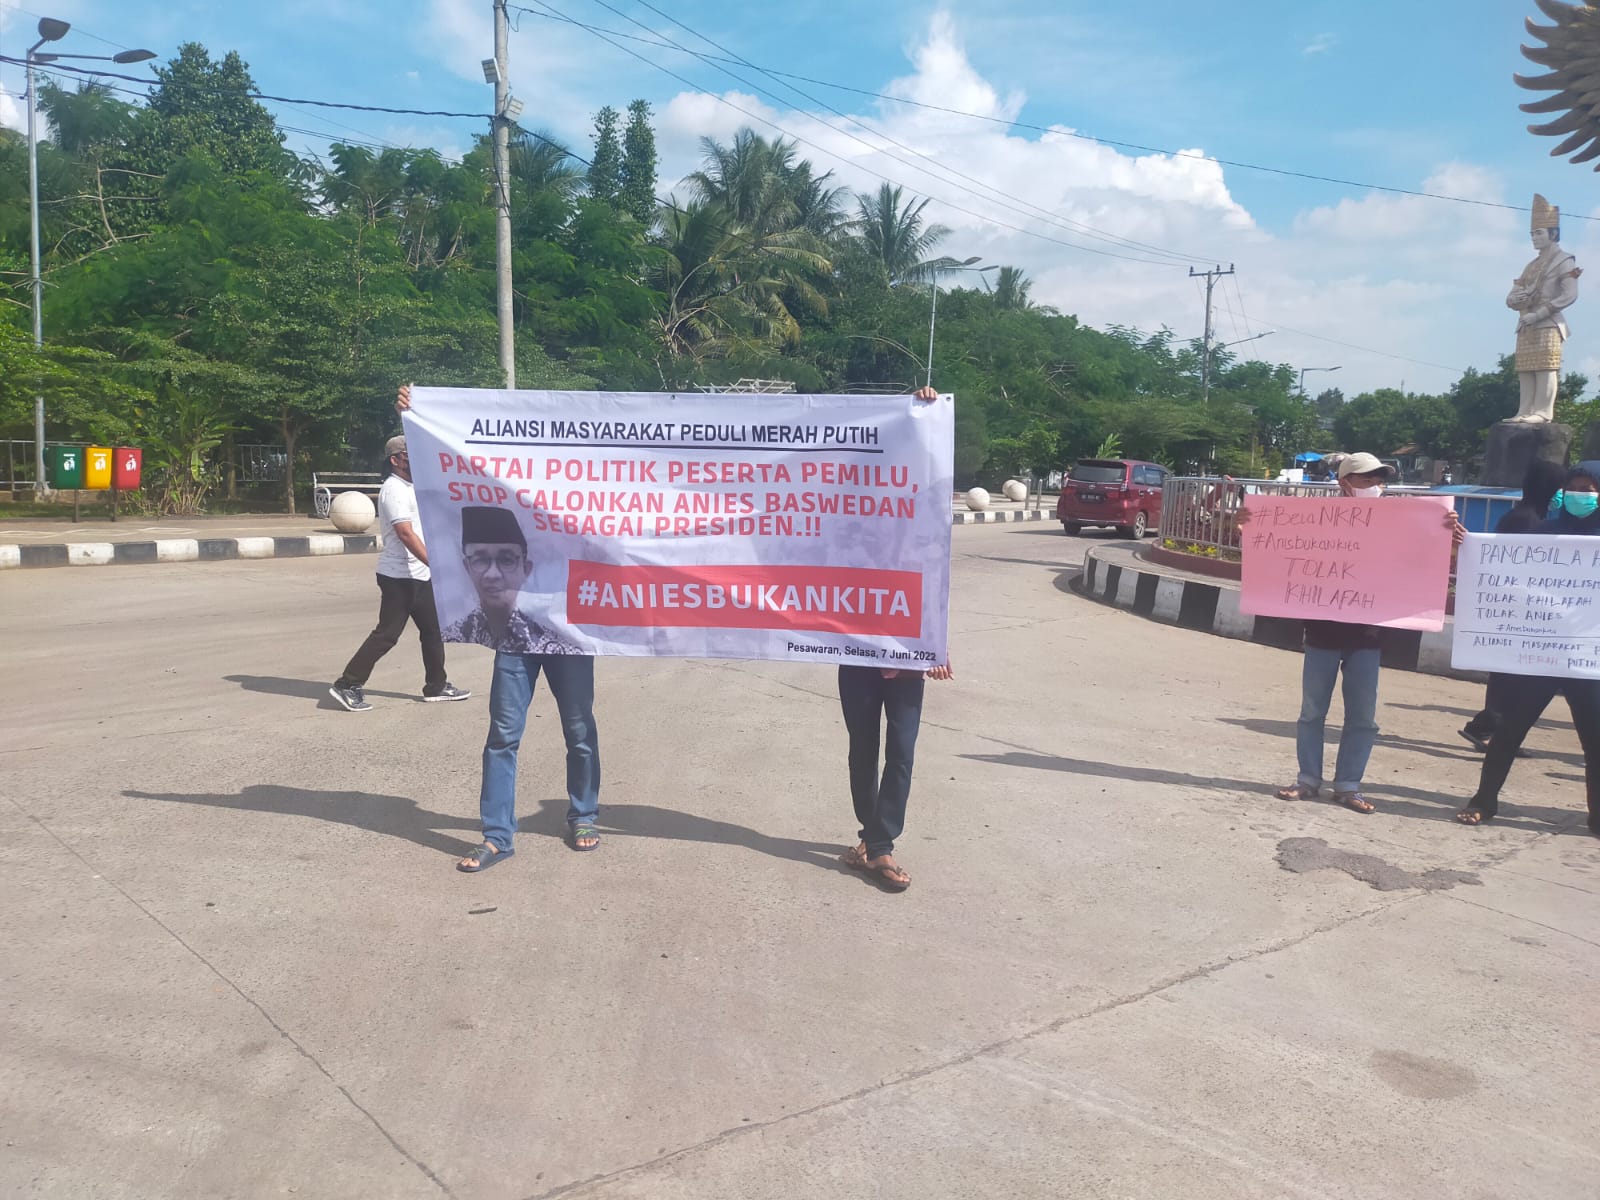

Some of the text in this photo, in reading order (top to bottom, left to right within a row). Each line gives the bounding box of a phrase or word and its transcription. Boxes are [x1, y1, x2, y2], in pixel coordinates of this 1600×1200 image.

[470, 418, 878, 445] ALIANSI MASYARAKAT PEDULI MERAH PUTIH
[438, 452, 919, 494] PARTAI POLITIK PESERTA PEMILU,
[448, 481, 915, 519] STOP CALONKAN ANIES BASWEDAN
[533, 512, 821, 537] SEBAGAI PRESIDEN.!!
[1284, 557, 1356, 580] TOLAK
[1478, 573, 1519, 588] TOLAK
[578, 579, 911, 617] #ANIESBUKANKITA
[1284, 581, 1375, 611] KHILAFAH
[1476, 592, 1593, 609] TOLAK KHILAFAH
[1475, 607, 1563, 621] TOLAK ANIES
[787, 642, 936, 661] Pesawaran, Selasa, 7 Juni 2022
[1522, 640, 1585, 651] MASYARAKAT
